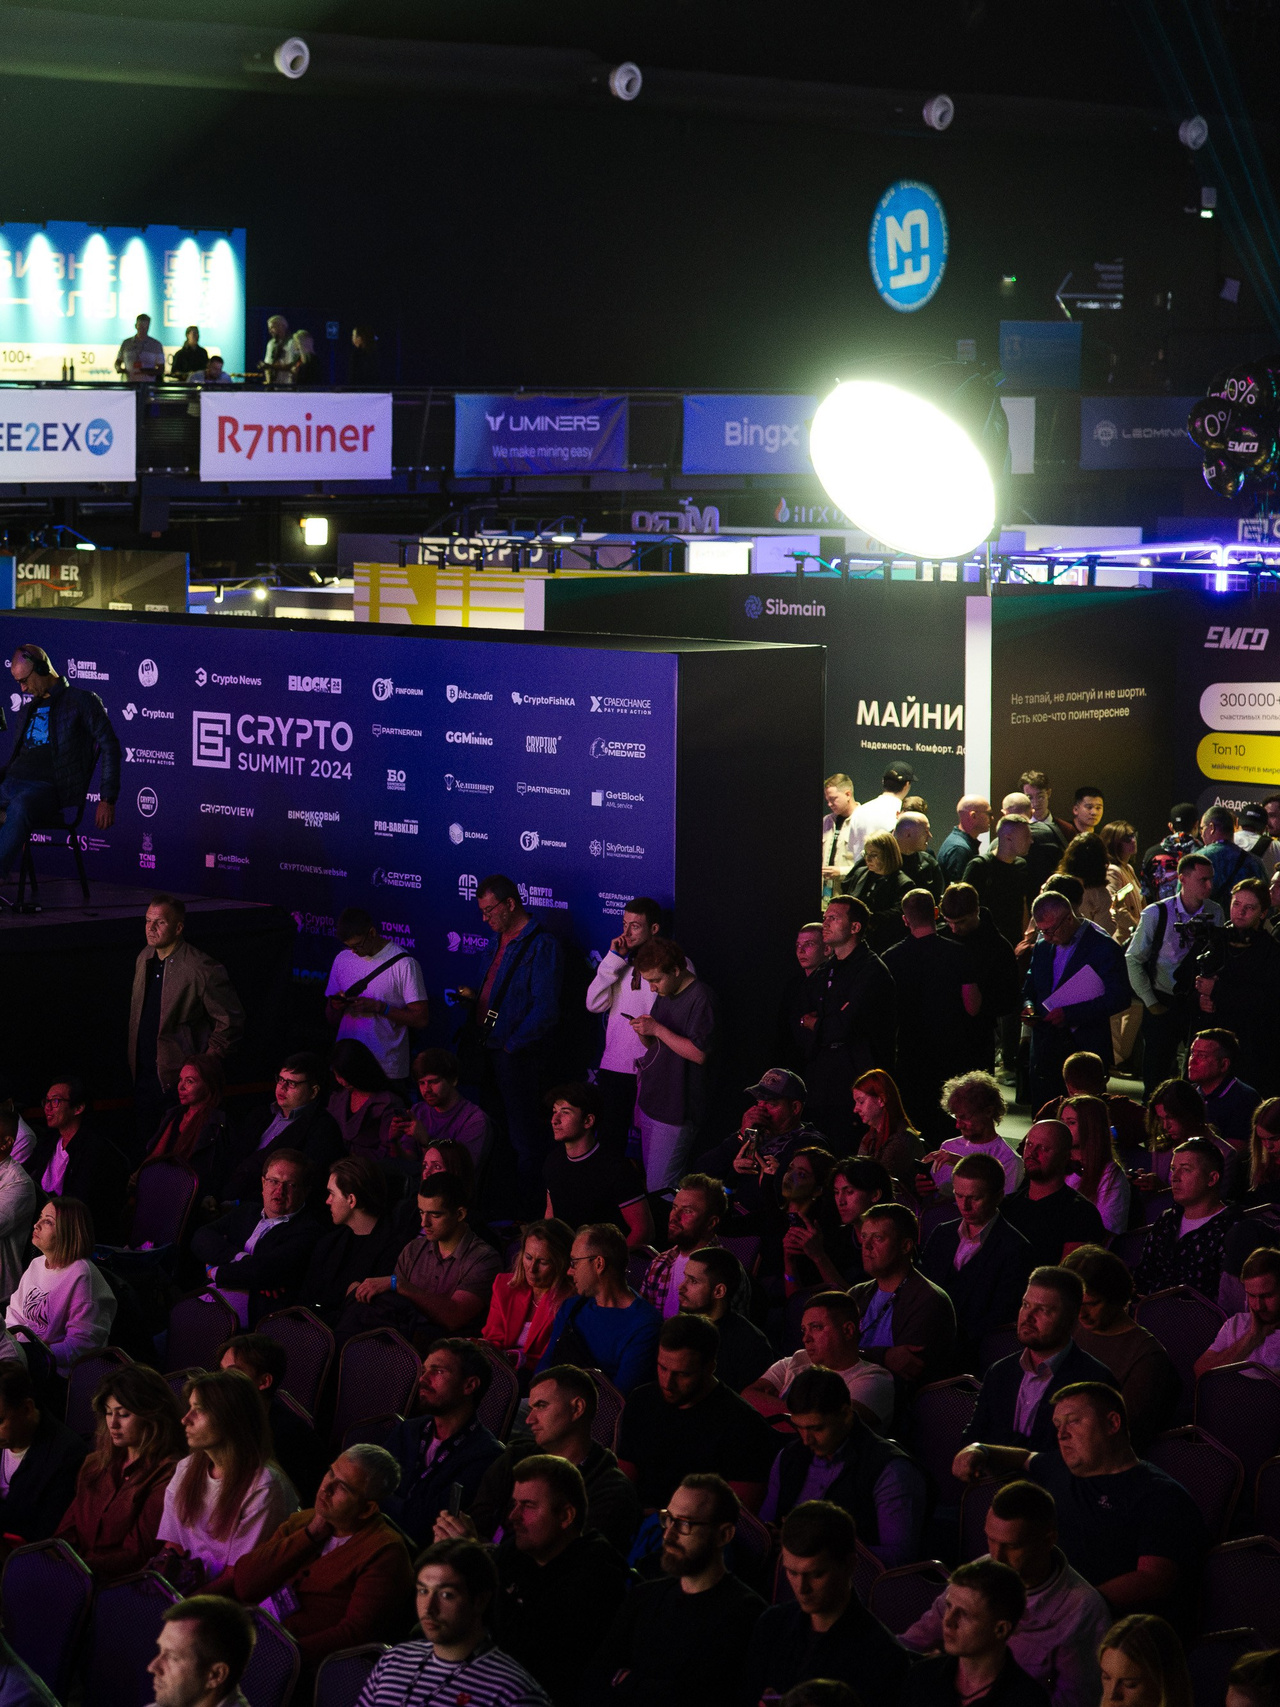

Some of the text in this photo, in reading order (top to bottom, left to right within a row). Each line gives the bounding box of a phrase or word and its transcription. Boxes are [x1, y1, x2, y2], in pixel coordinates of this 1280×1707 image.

[2, 350, 31, 363] 100+
[81, 352, 95, 364] 30
[218, 412, 375, 460] R7miner
[492, 445, 593, 460] We make mining easy
[765, 598, 826, 617] Sibmain
[77, 661, 97, 671] CRYPTO
[211, 673, 262, 686] Crypto News
[395, 687, 424, 697] FINFORUM
[458, 689, 494, 701] bits.media
[1011, 693, 1023, 705] Не
[1025, 691, 1053, 705] тапай,
[1054, 692, 1065, 703] не
[1066, 688, 1096, 703] лонгуй
[1105, 689, 1116, 698] не
[1117, 687, 1147, 700] шорти.
[523, 695, 575, 706] CryptoFishKA
[603, 697, 652, 709] CPAEXCHANGE
[141, 707, 175, 720] Crypto.ru
[1011, 707, 1130, 724] Есть кое-что поинтереснее
[237, 714, 354, 752] CRYPTO
[381, 726, 422, 737] PARTNERKIN
[608, 742, 646, 751] CRYPTO
[861, 740, 913, 752] Надежность.
[915, 742, 954, 755] Комфорт.
[1212, 743, 1246, 757] Топ 10
[136, 748, 175, 760] CPAEXCHANGE
[608, 749, 646, 758] MEDWED
[238, 752, 352, 780] SUMMIT 2024
[527, 785, 571, 796] PARTNERKIN
[606, 790, 645, 802] GetBlock
[200, 803, 255, 817] CRYPTOVIEW
[464, 831, 488, 840] BLOMAG
[541, 839, 567, 848] FINFORUM
[606, 842, 645, 854] SkyPortal.Ru
[217, 853, 250, 864] GetBlock
[279, 862, 347, 878] CRYPTONEWS.website
[387, 872, 422, 882] CRYPTO
[387, 879, 422, 889] MEDWED
[529, 886, 552, 897] CRYPTO
[529, 896, 568, 910] FINGERS.com
[305, 912, 334, 926] Crypto
[381, 921, 411, 934] ТОЧКА
